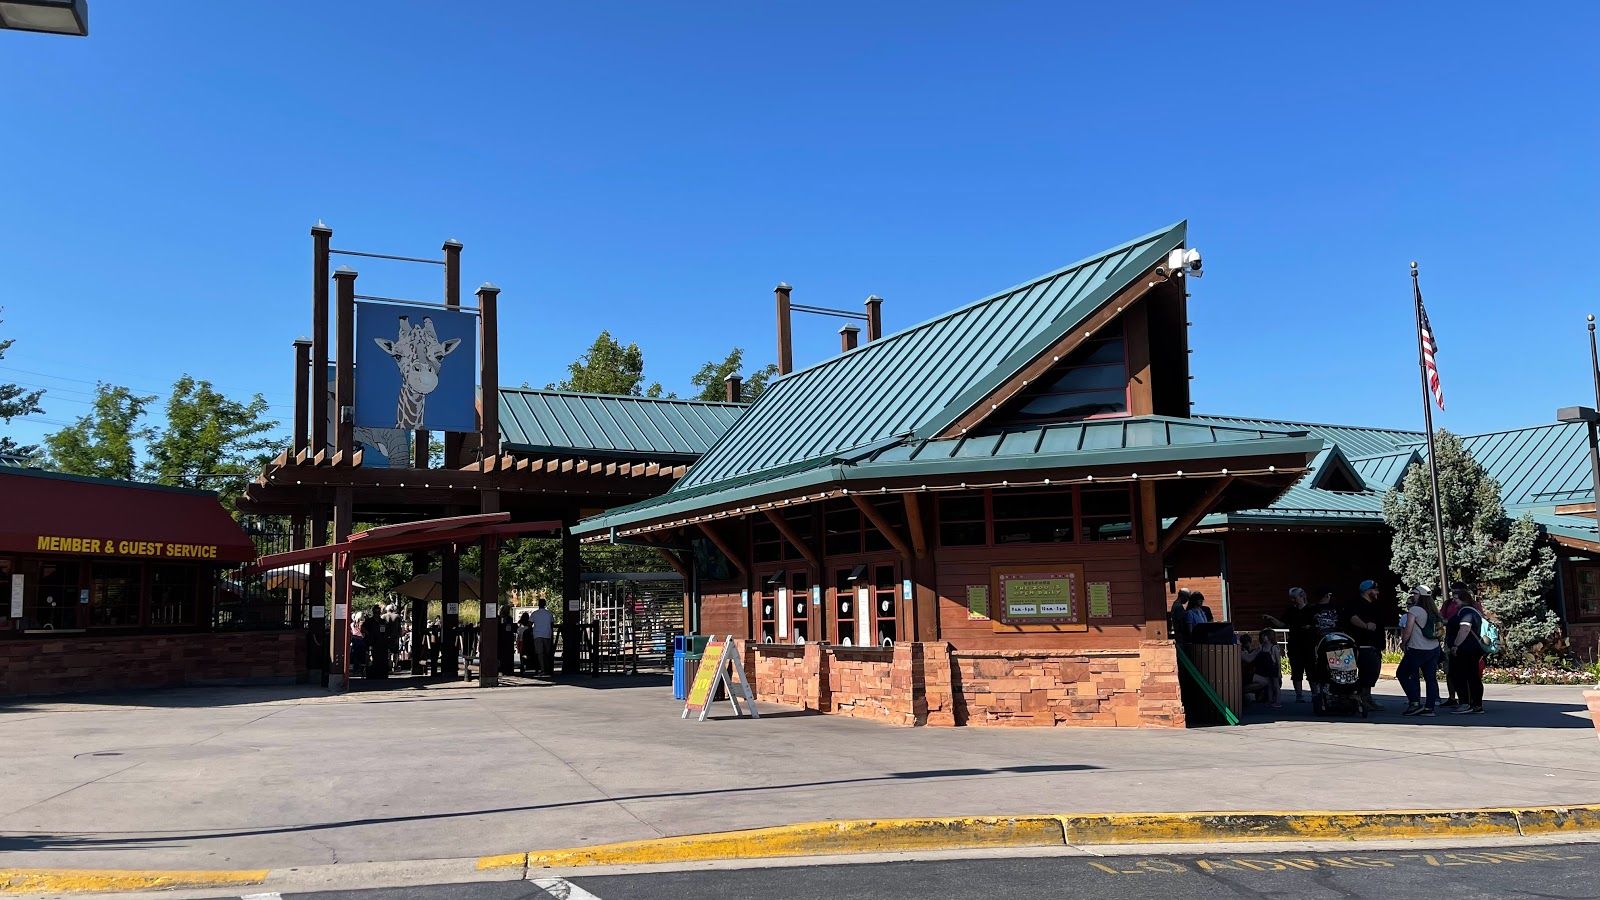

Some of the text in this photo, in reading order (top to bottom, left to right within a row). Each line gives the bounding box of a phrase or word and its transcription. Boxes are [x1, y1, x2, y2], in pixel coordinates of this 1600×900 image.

[37, 536, 217, 558] MEMBER & GUEST SERVICE
[1089, 850, 1583, 874] LOADING ZONE
